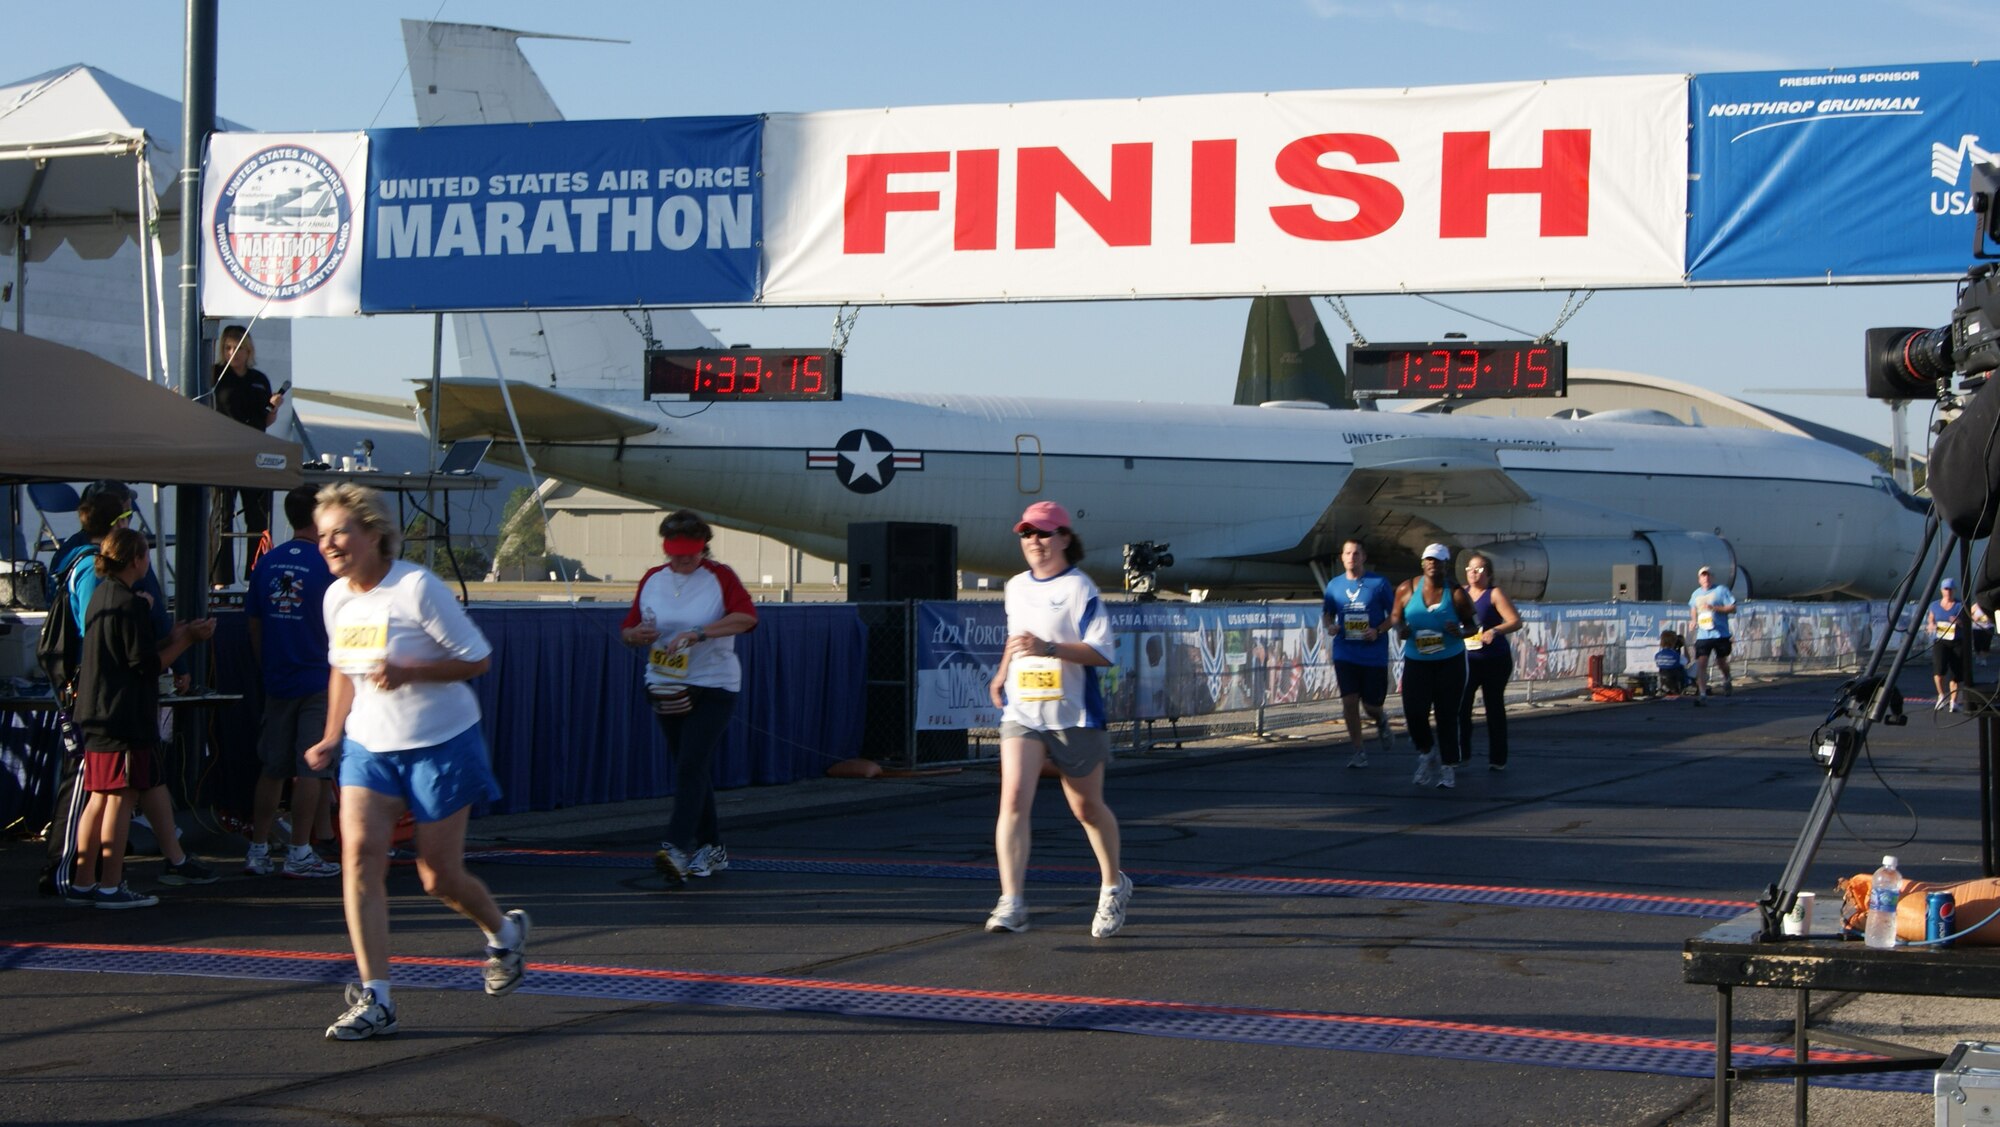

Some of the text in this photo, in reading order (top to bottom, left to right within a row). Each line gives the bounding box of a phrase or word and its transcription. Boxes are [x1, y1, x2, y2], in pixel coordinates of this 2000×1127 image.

[1779, 71, 1920, 88] PRESENTING SPONSOR
[1708, 97, 1920, 117] NORTHROP GRUMMAN
[225, 148, 345, 197] UNITED STATES AIR FORCE
[379, 167, 750, 200] UNITED STATES AIR FORCE
[843, 128, 1592, 255] FINISH
[376, 193, 754, 260] MARATHON
[216, 222, 279, 298] WRIGHT-PATTERSON
[281, 284, 302, 297] AFB
[337, 221, 350, 251] OHIO
[237, 235, 328, 258] MARATHON
[928, 715, 953, 726] FULL
